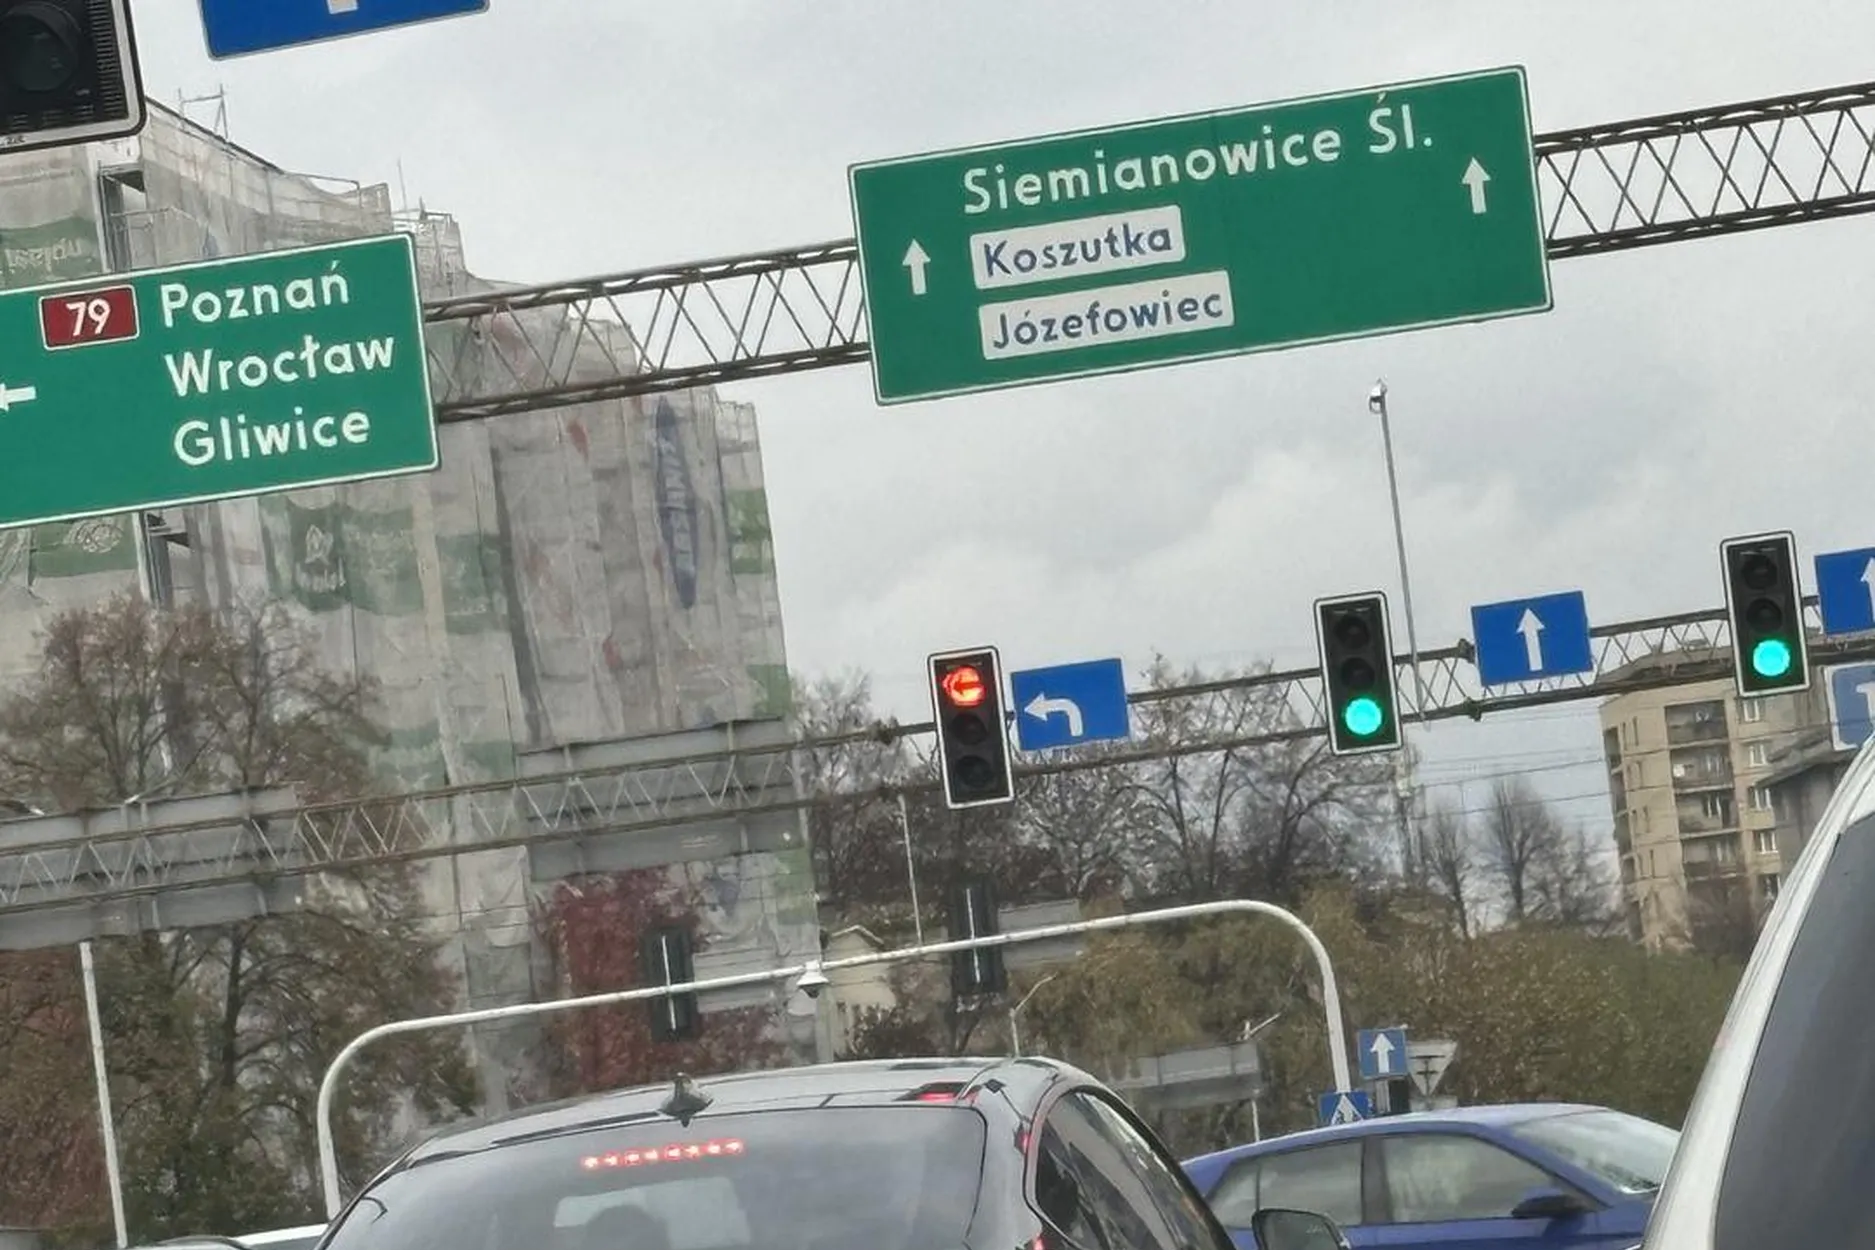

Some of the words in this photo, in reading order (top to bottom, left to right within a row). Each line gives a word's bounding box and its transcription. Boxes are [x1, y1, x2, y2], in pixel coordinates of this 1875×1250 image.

[963, 124, 1341, 214] Siemianowice
[1368, 93, 1434, 154] Śl.
[983, 222, 1173, 278] Koszutka
[65, 298, 112, 338] 79
[159, 260, 350, 328] Poznań
[992, 289, 1224, 350] Józefowiec
[164, 334, 395, 397] Wrocław
[174, 407, 371, 467] Gliwice
